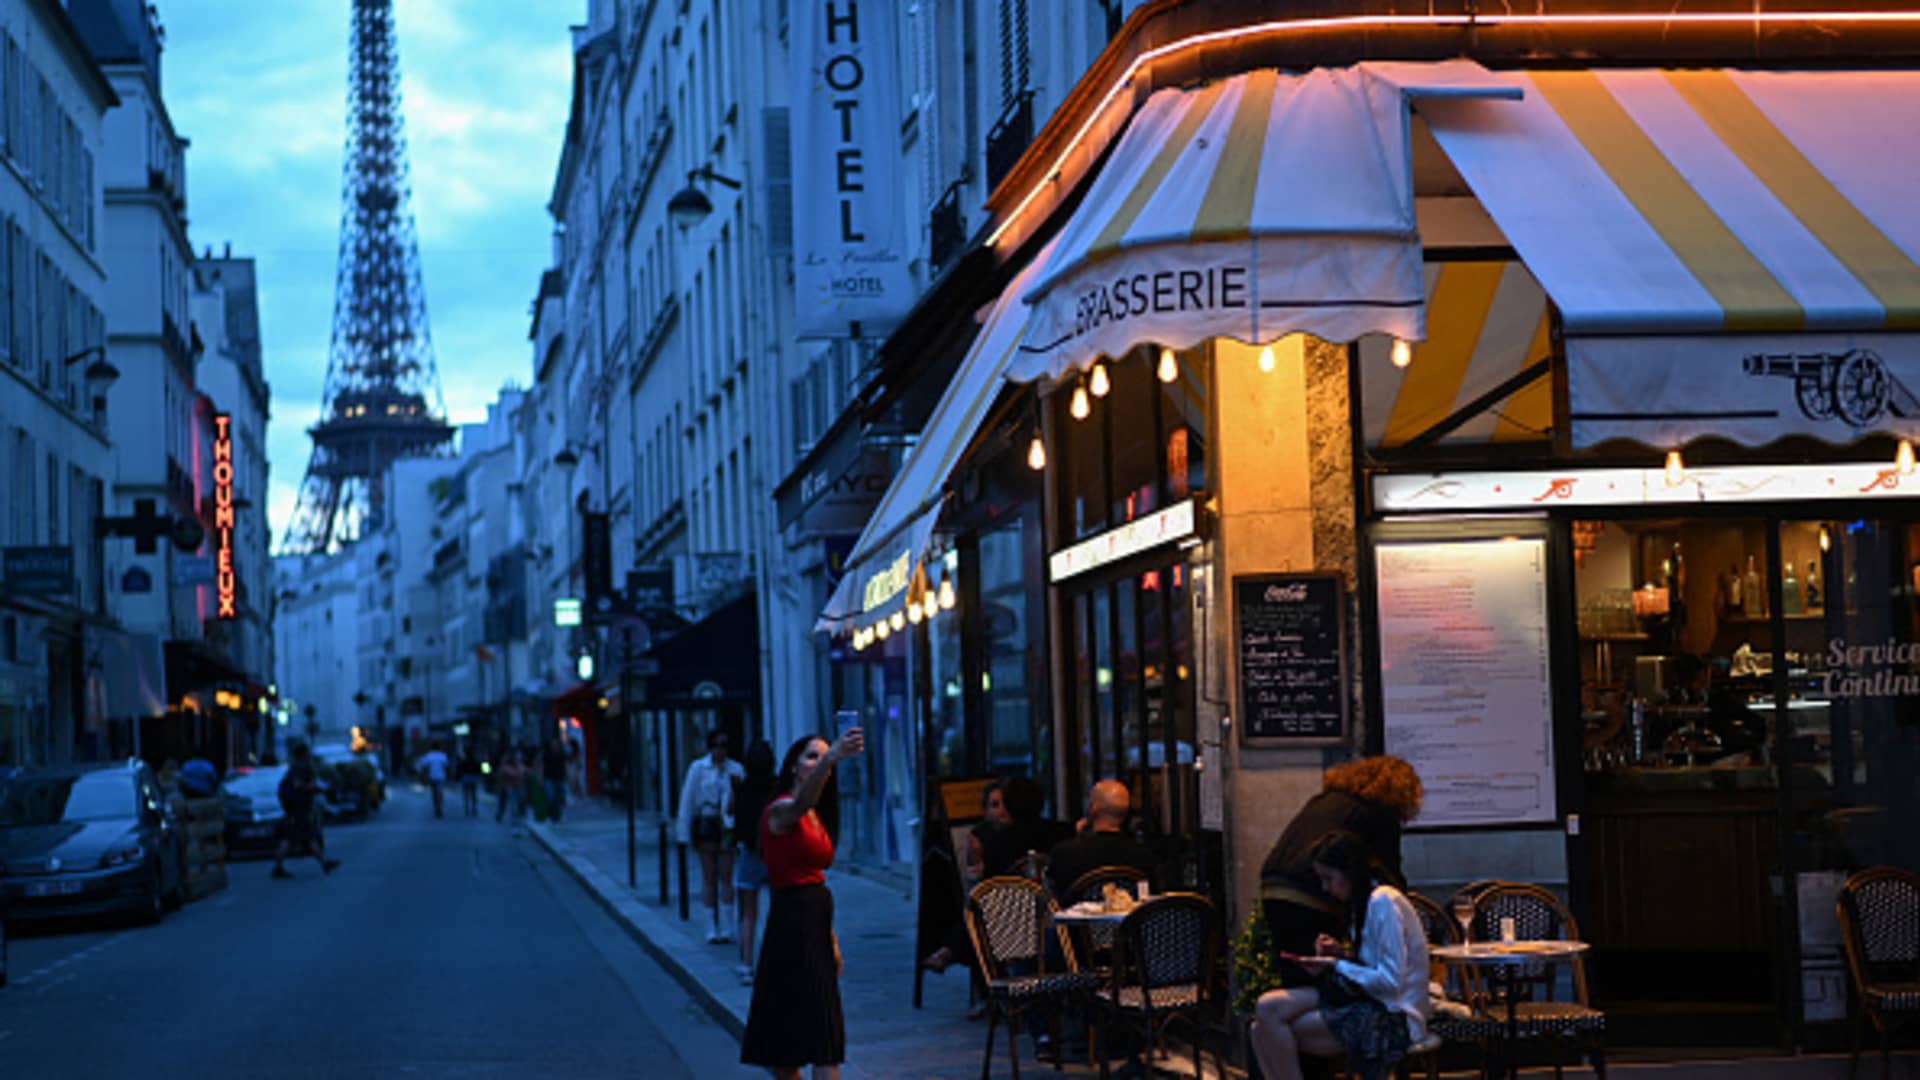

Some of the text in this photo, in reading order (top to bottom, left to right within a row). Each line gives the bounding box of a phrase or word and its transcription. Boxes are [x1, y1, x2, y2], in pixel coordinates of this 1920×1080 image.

[825, 1, 865, 243] HOTEL
[831, 276, 885, 293] HOTEL
[1075, 267, 1247, 336] BRASSERIE
[213, 415, 235, 619] THOUMIEUX
